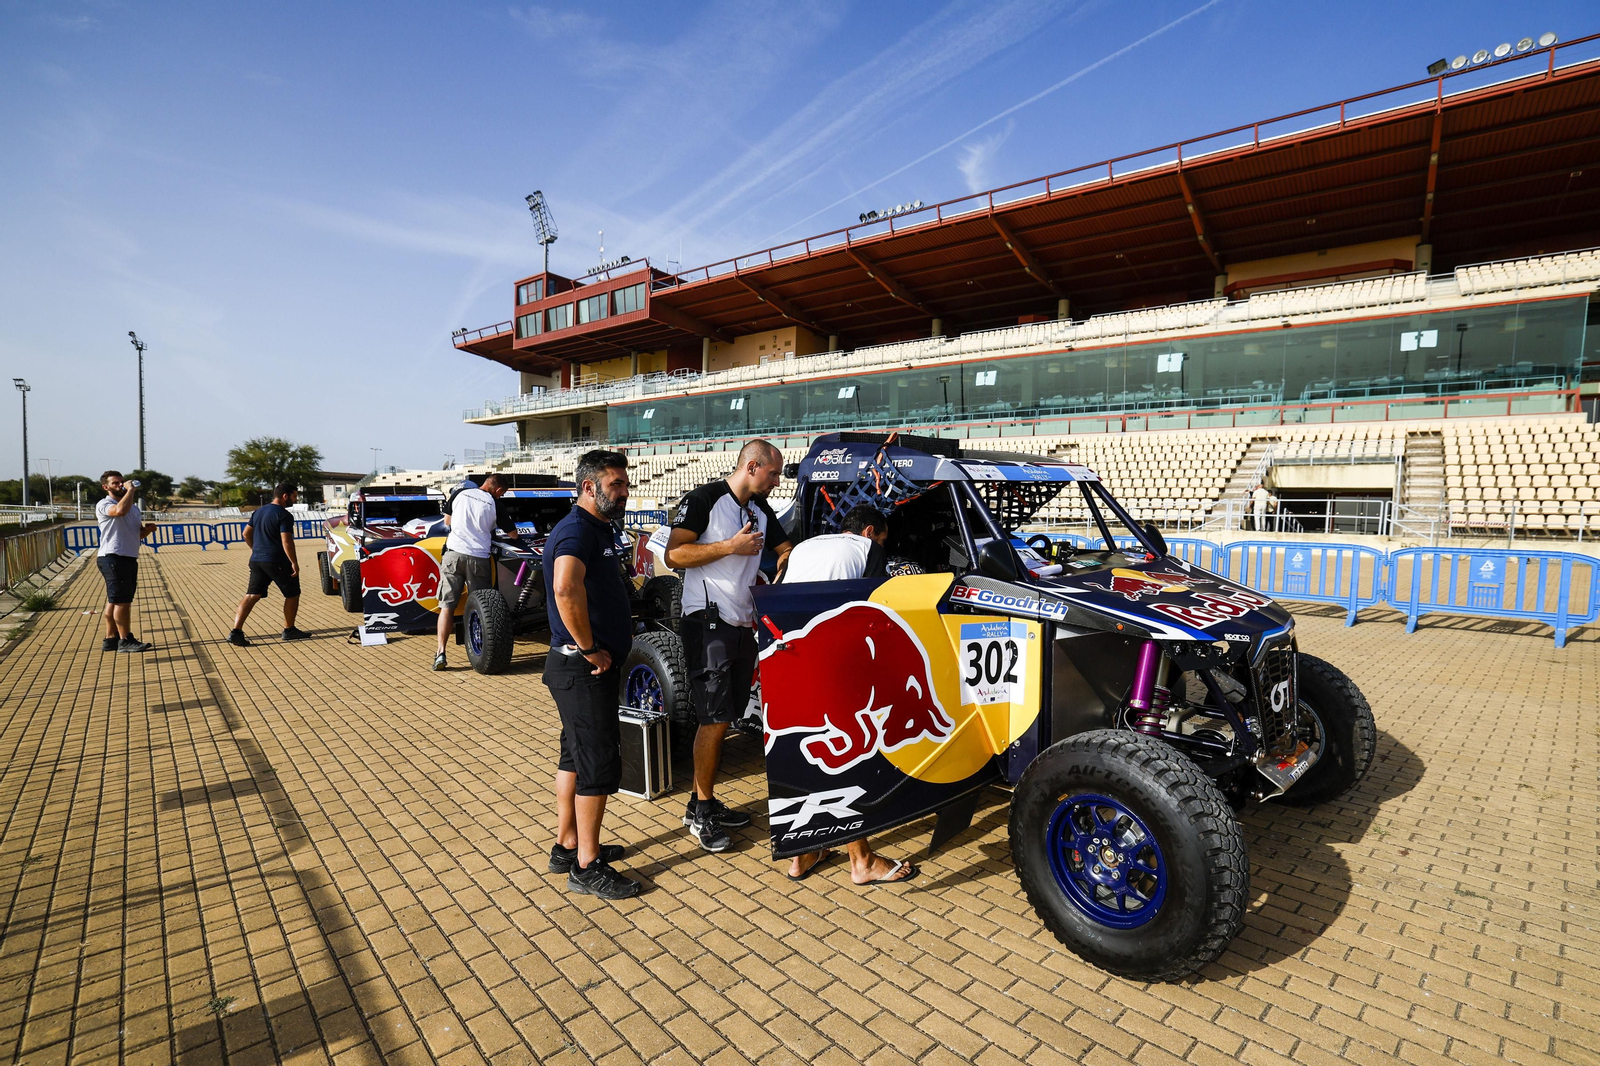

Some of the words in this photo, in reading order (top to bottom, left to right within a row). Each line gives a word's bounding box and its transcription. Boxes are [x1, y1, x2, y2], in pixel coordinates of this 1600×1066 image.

[814, 453, 852, 465] MOBILE
[811, 470, 840, 480] sparco
[952, 585, 1069, 615] BFGoodrich
[1224, 633, 1250, 641] sparco
[964, 639, 1019, 687] 302
[781, 820, 864, 841] RACING
